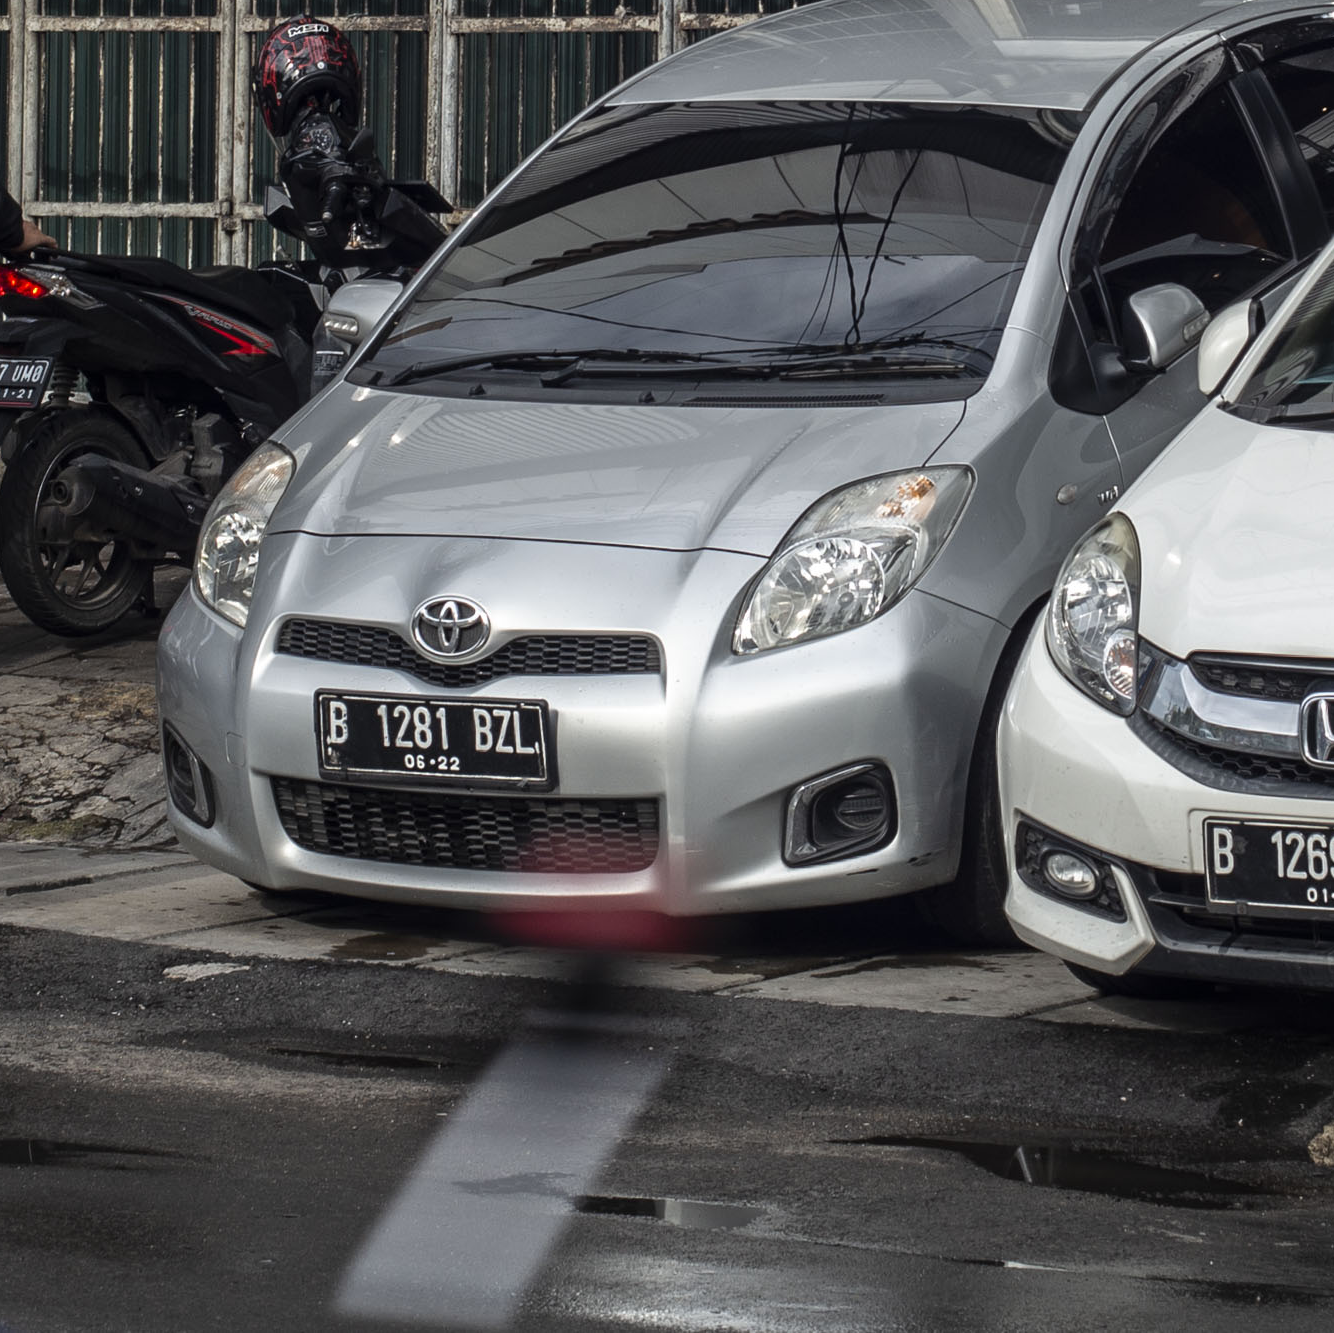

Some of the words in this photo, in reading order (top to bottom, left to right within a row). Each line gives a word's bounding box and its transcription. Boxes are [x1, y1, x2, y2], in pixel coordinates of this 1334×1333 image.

[328, 700, 349, 745] B
[377, 704, 449, 751] 1281
[473, 708, 535, 754] BZL
[1213, 827, 1234, 875] B
